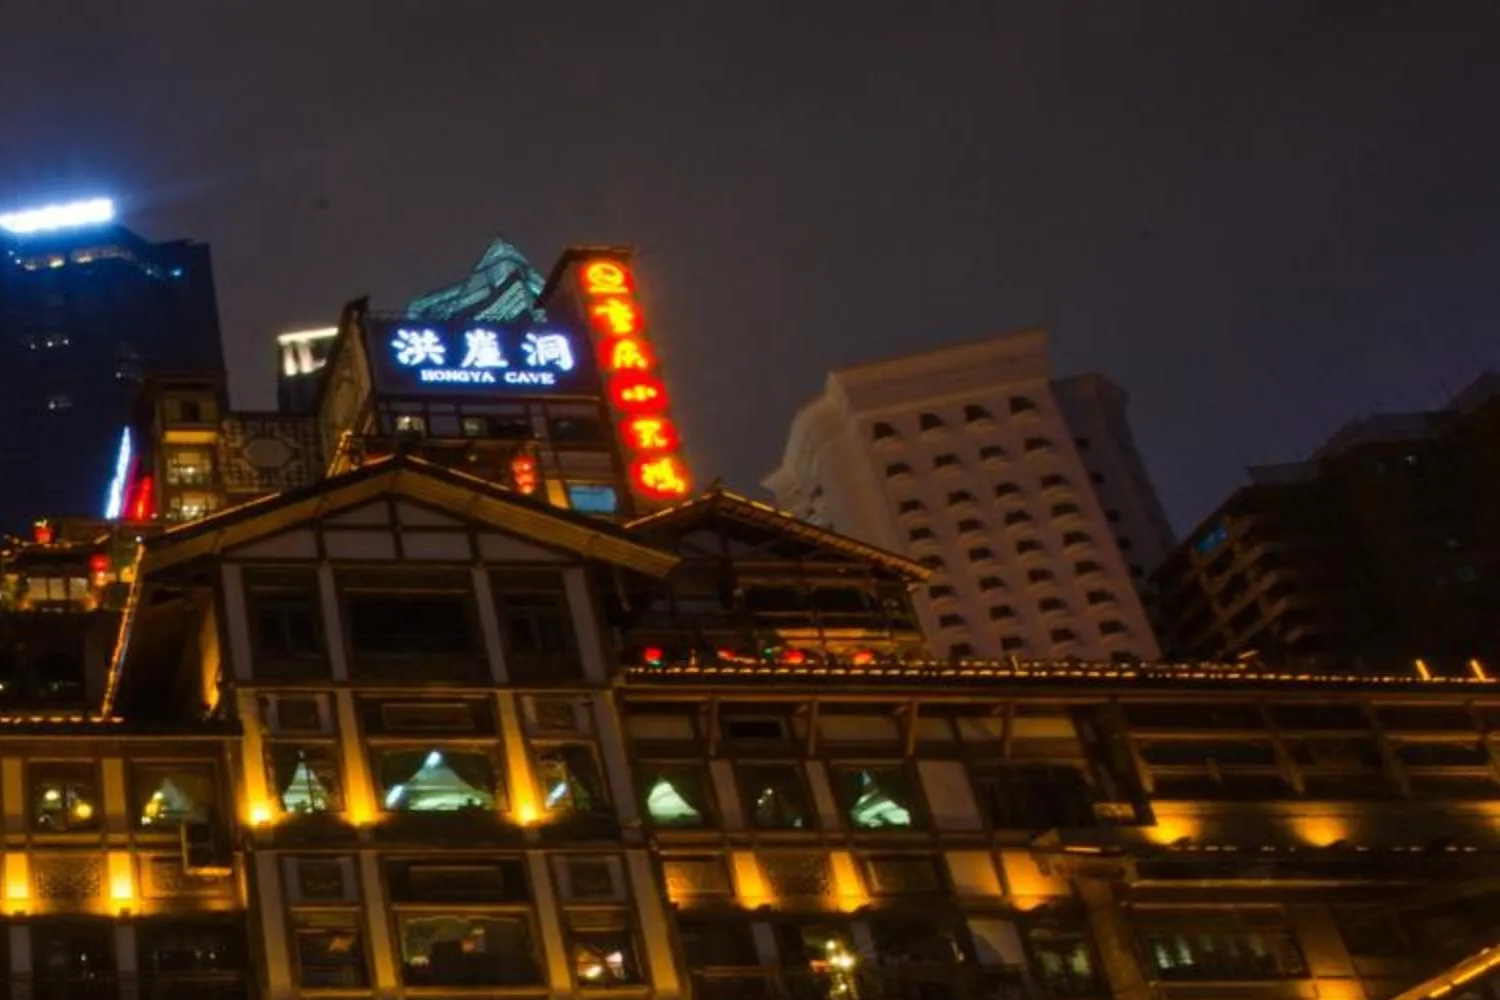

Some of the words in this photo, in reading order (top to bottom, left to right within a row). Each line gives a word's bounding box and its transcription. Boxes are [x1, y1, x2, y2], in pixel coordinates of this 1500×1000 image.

[391, 328, 575, 371] 洪崖洞
[420, 370, 496, 384] HONGYA
[504, 371, 556, 385] CAVE
